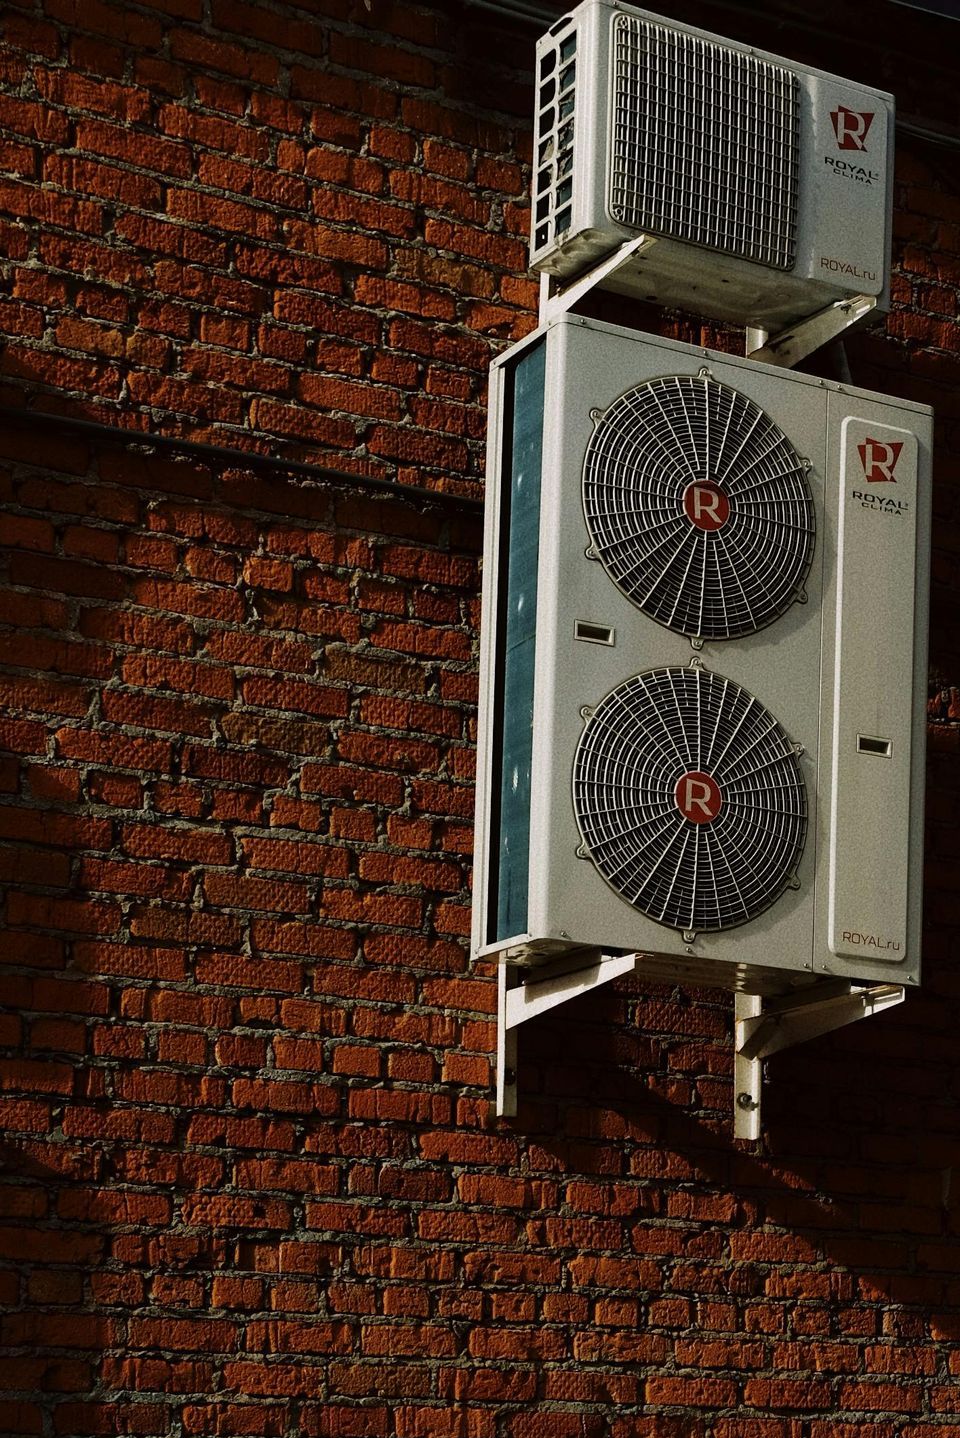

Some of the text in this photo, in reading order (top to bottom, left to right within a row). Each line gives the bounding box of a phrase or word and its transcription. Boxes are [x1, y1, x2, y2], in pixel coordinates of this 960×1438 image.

[824, 156, 879, 181] ROYAL
[833, 168, 872, 185] CLIMA
[820, 257, 876, 281] ROYAL.ru
[693, 486, 723, 523] R
[852, 490, 909, 511] ROYAL
[861, 502, 902, 515] CLIMA
[685, 778, 714, 817] R
[842, 931, 900, 951] ROYAL.ru
